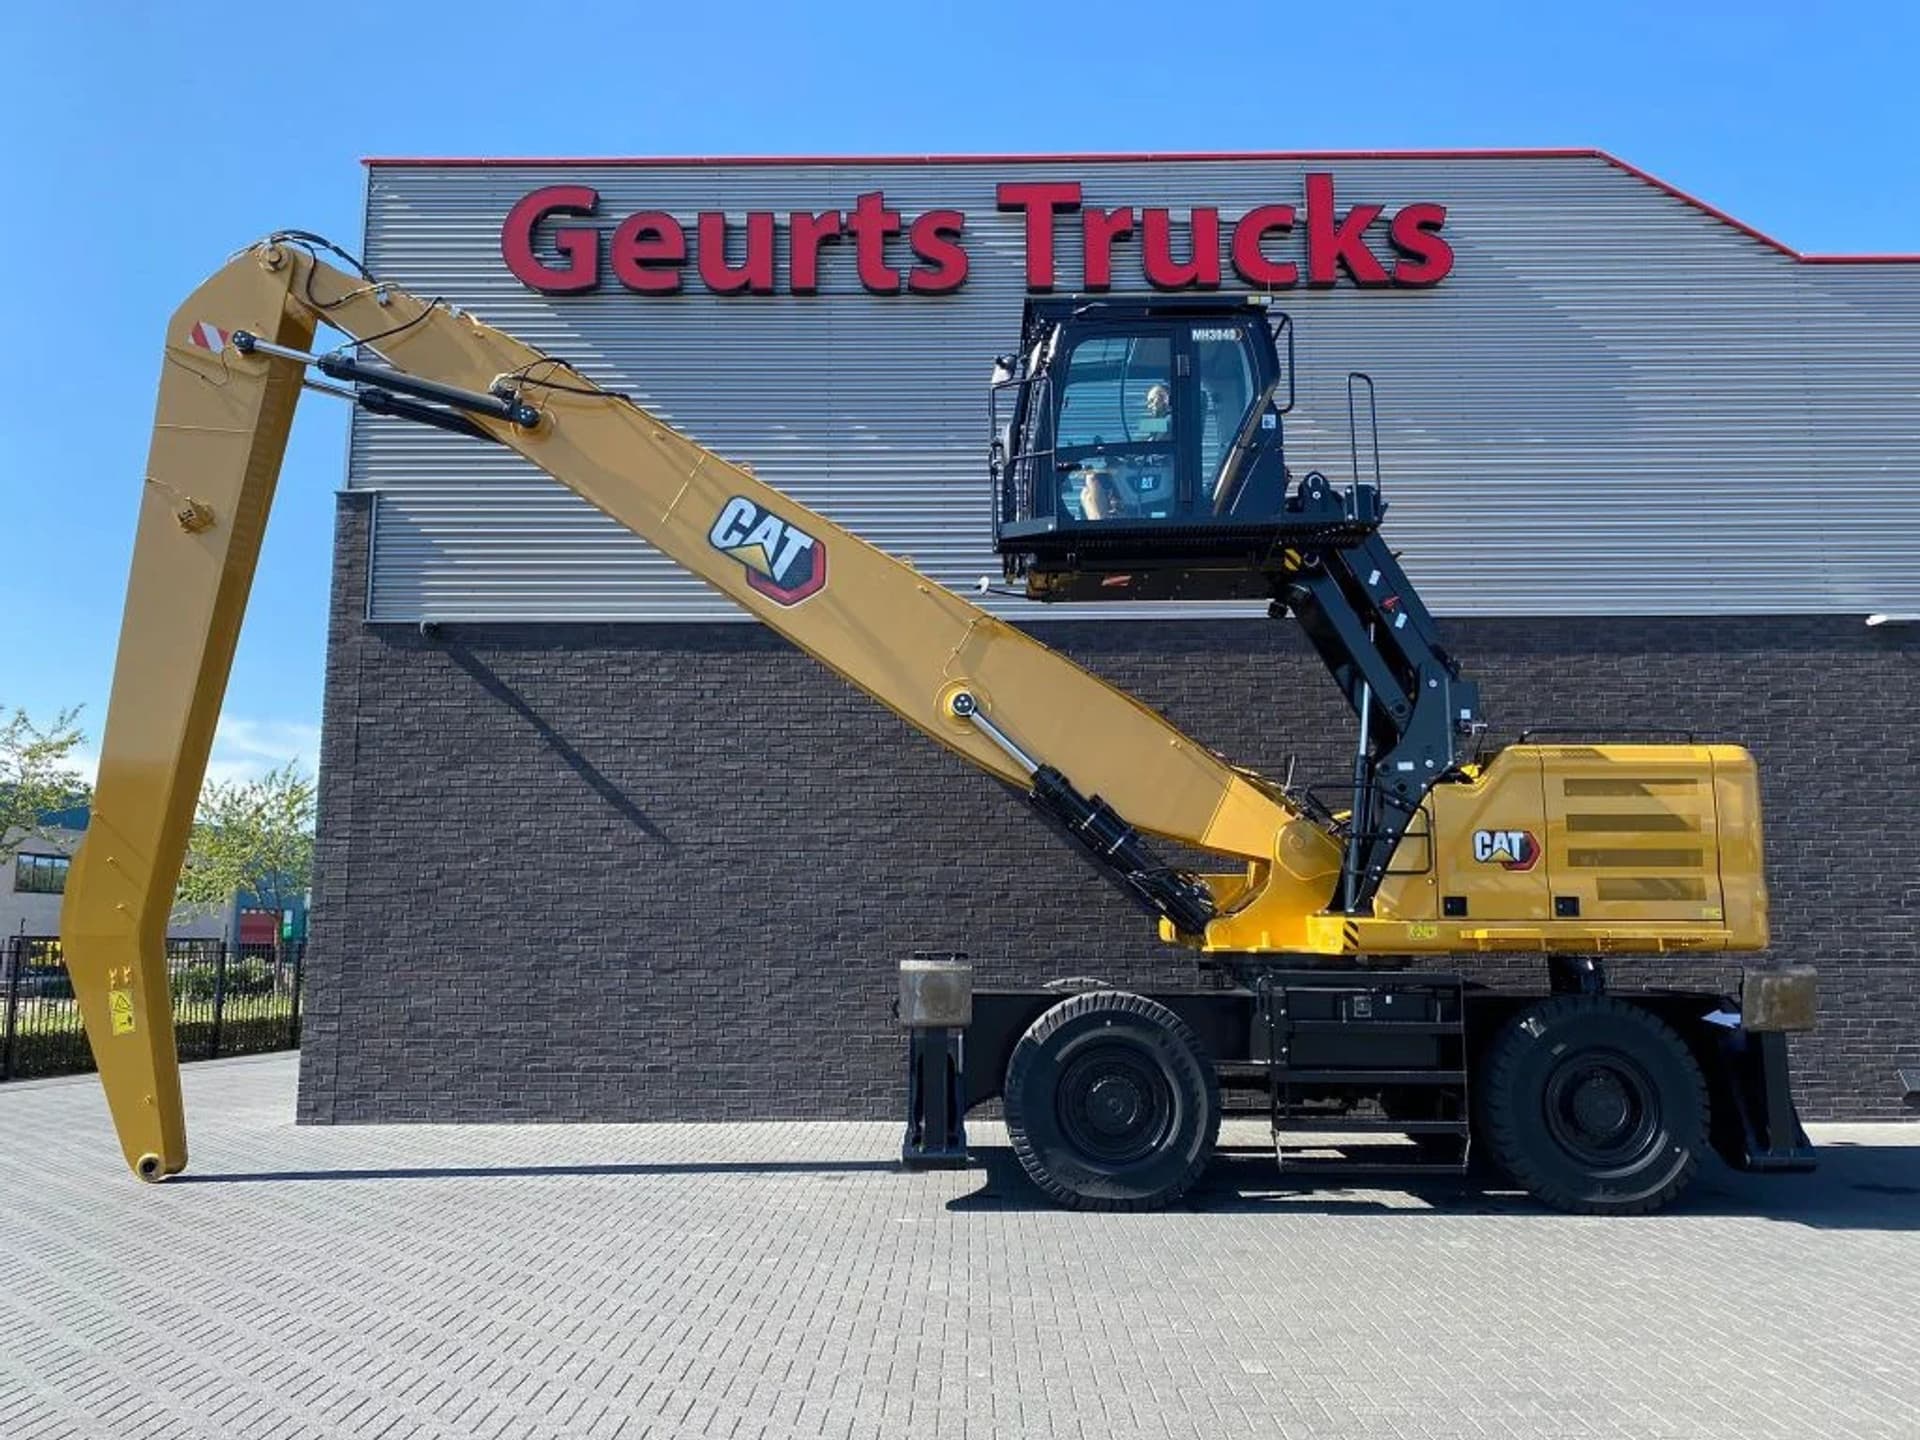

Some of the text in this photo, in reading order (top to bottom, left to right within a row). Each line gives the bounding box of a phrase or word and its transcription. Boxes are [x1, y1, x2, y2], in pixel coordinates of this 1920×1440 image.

[501, 173, 1454, 295] Geurts Trucks
[709, 496, 815, 583] CAT
[1474, 830, 1524, 862] CAT
